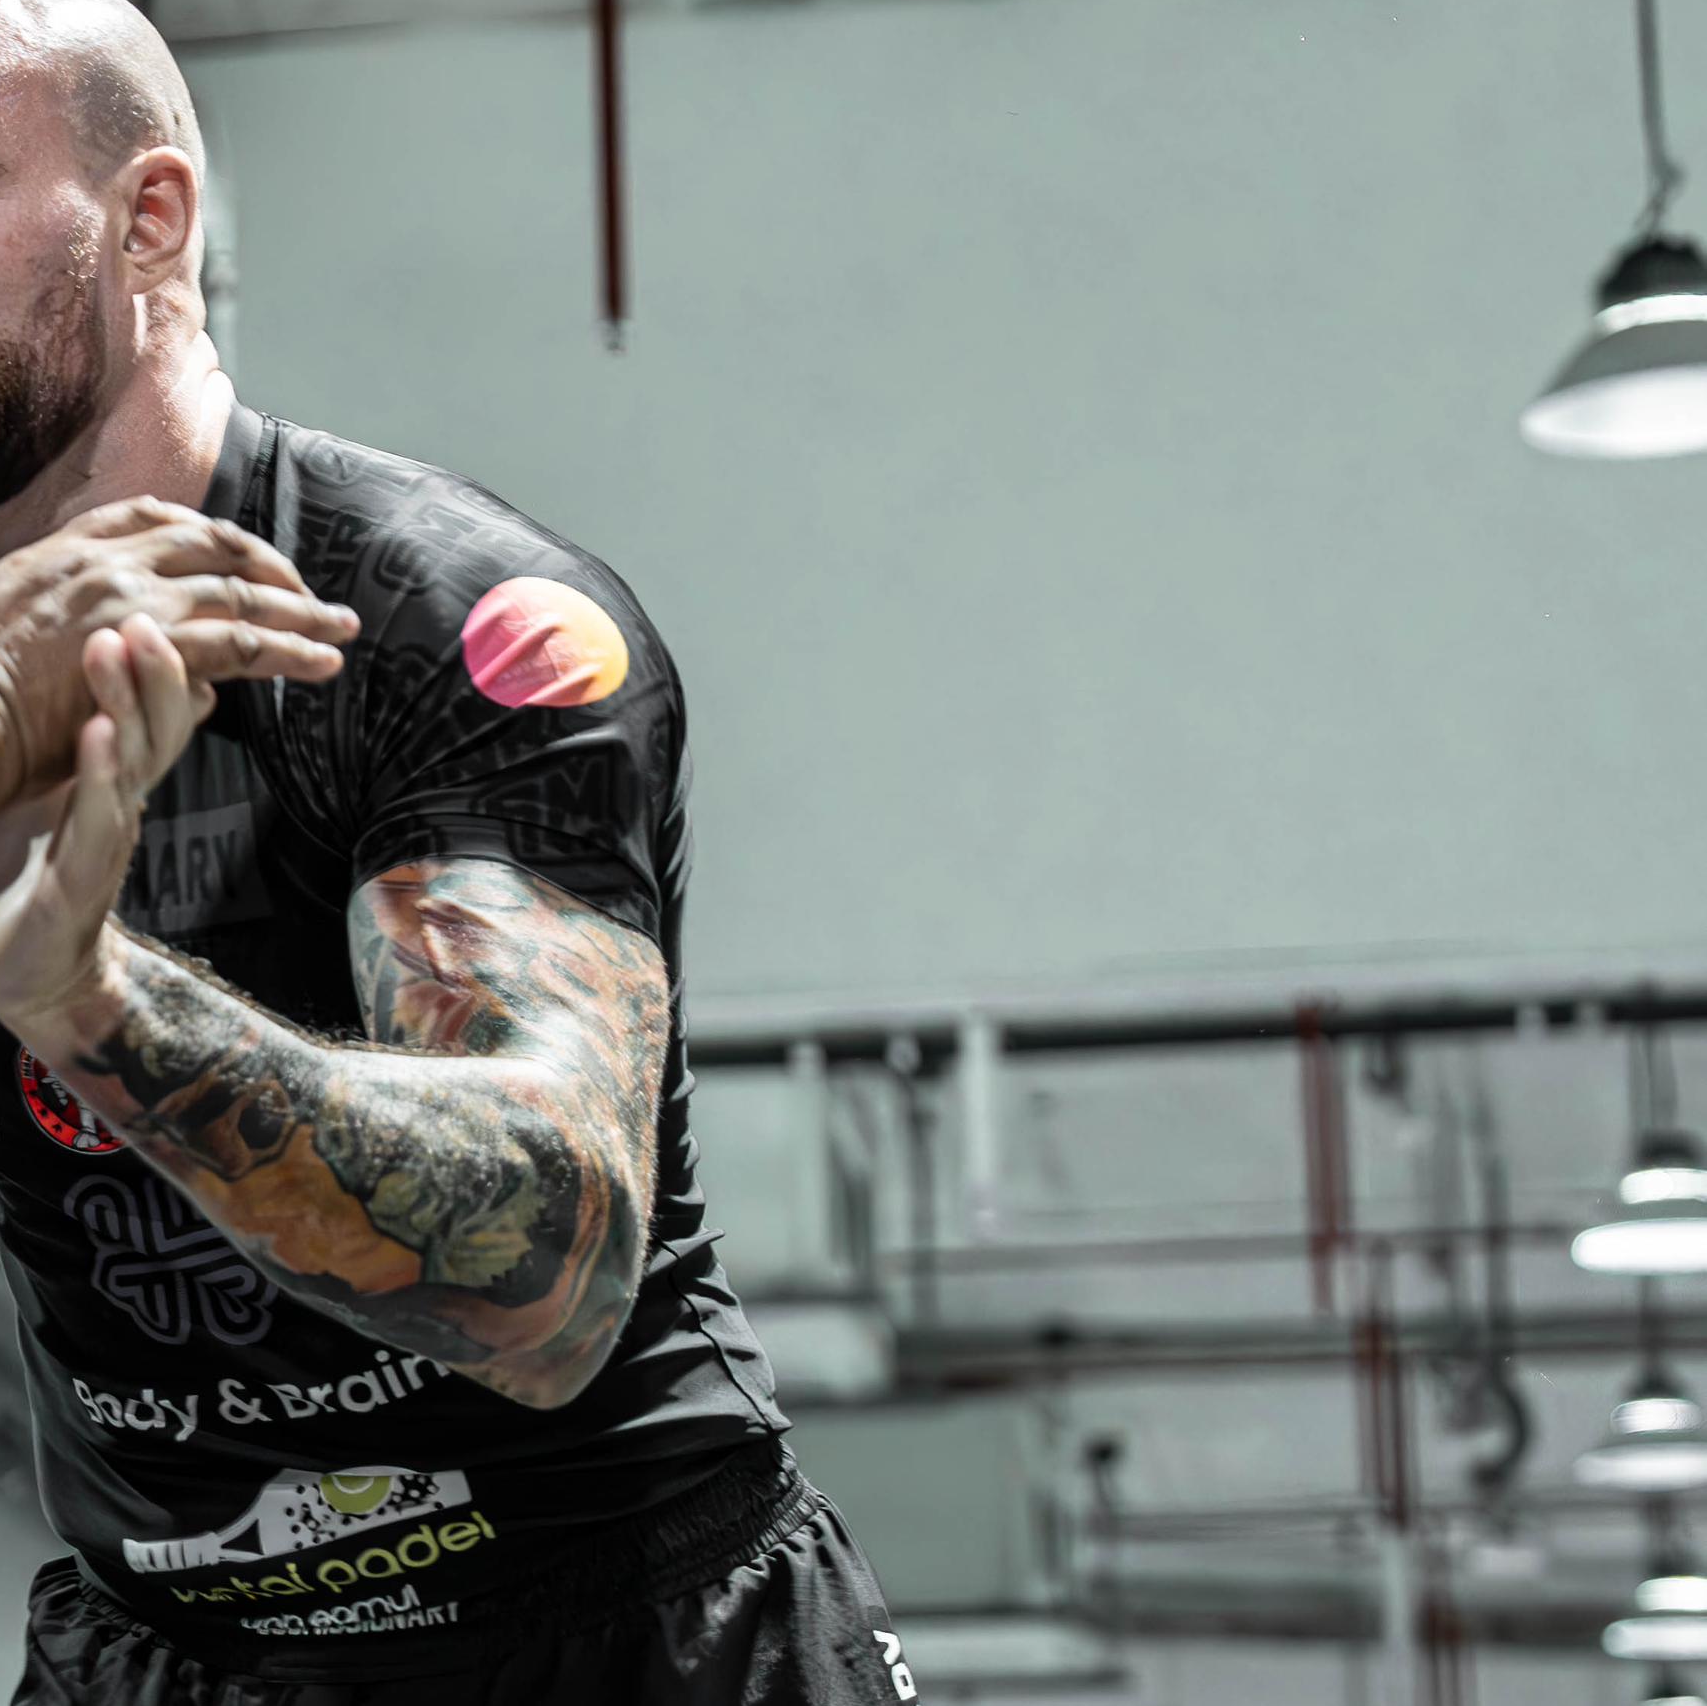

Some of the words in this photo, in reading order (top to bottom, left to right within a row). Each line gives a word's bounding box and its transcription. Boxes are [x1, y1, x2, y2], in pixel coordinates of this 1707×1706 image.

[72, 1377, 199, 1442] Body
[217, 1377, 273, 1425] &
[266, 1349, 451, 1419] Brain
[315, 1509, 498, 1594] padel
